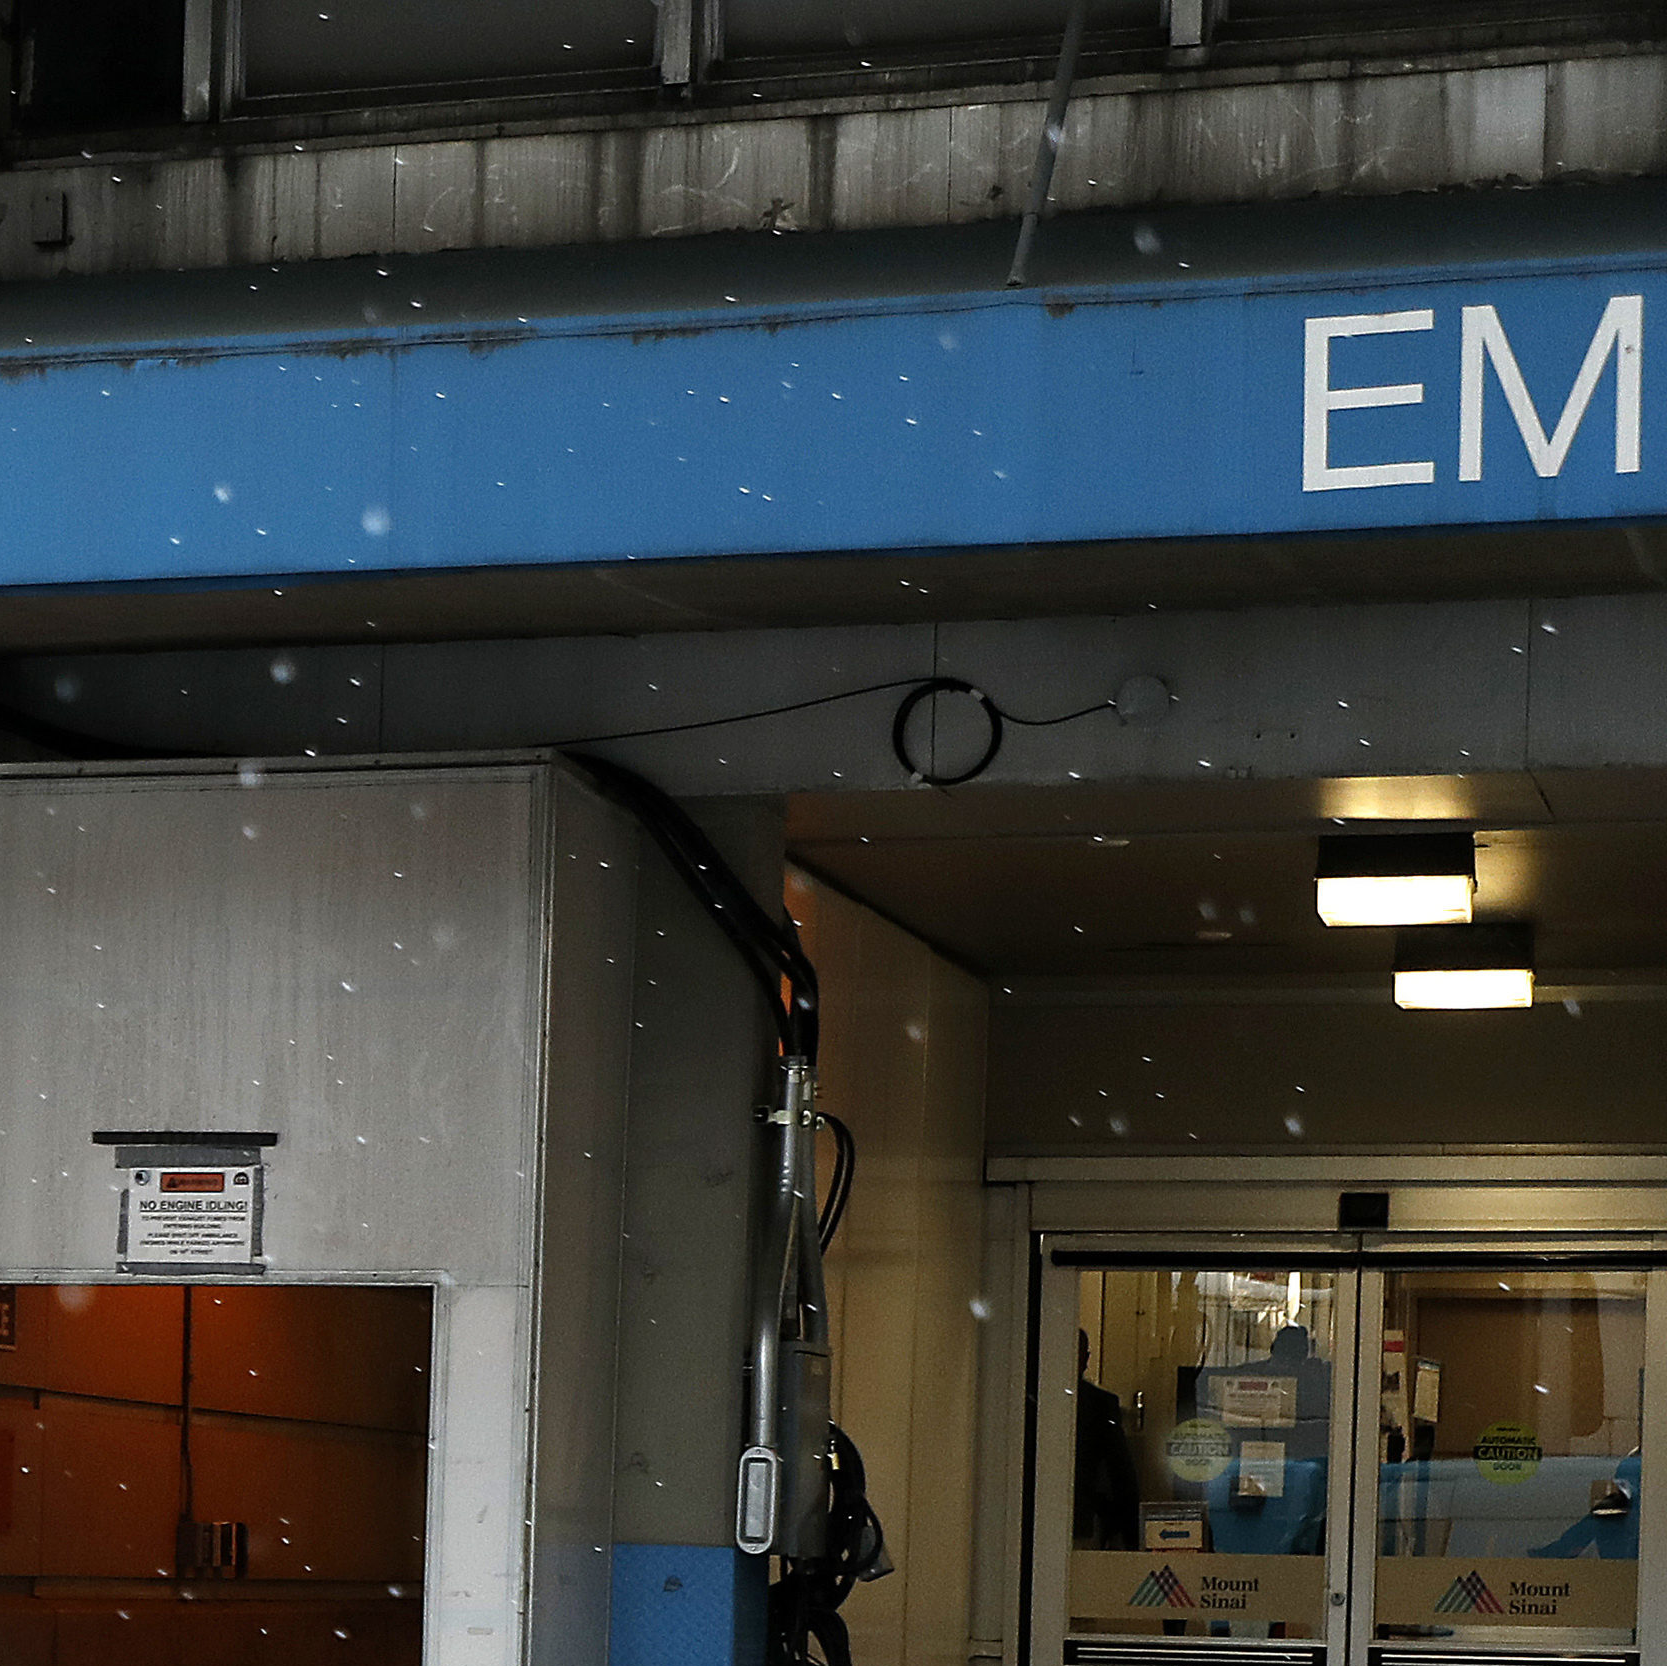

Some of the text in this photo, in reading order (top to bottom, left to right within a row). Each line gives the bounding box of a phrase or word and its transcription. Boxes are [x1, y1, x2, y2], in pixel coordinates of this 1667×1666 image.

[140, 1200, 157, 1211] NO
[160, 1200, 203, 1211] ENGINE
[1478, 1447, 1538, 1460] CAUTION
[1201, 1576, 1260, 1592] Mount
[1509, 1581, 1571, 1597] Mount
[1200, 1593, 1247, 1609] Sinai
[1509, 1599, 1557, 1615] Sinai
